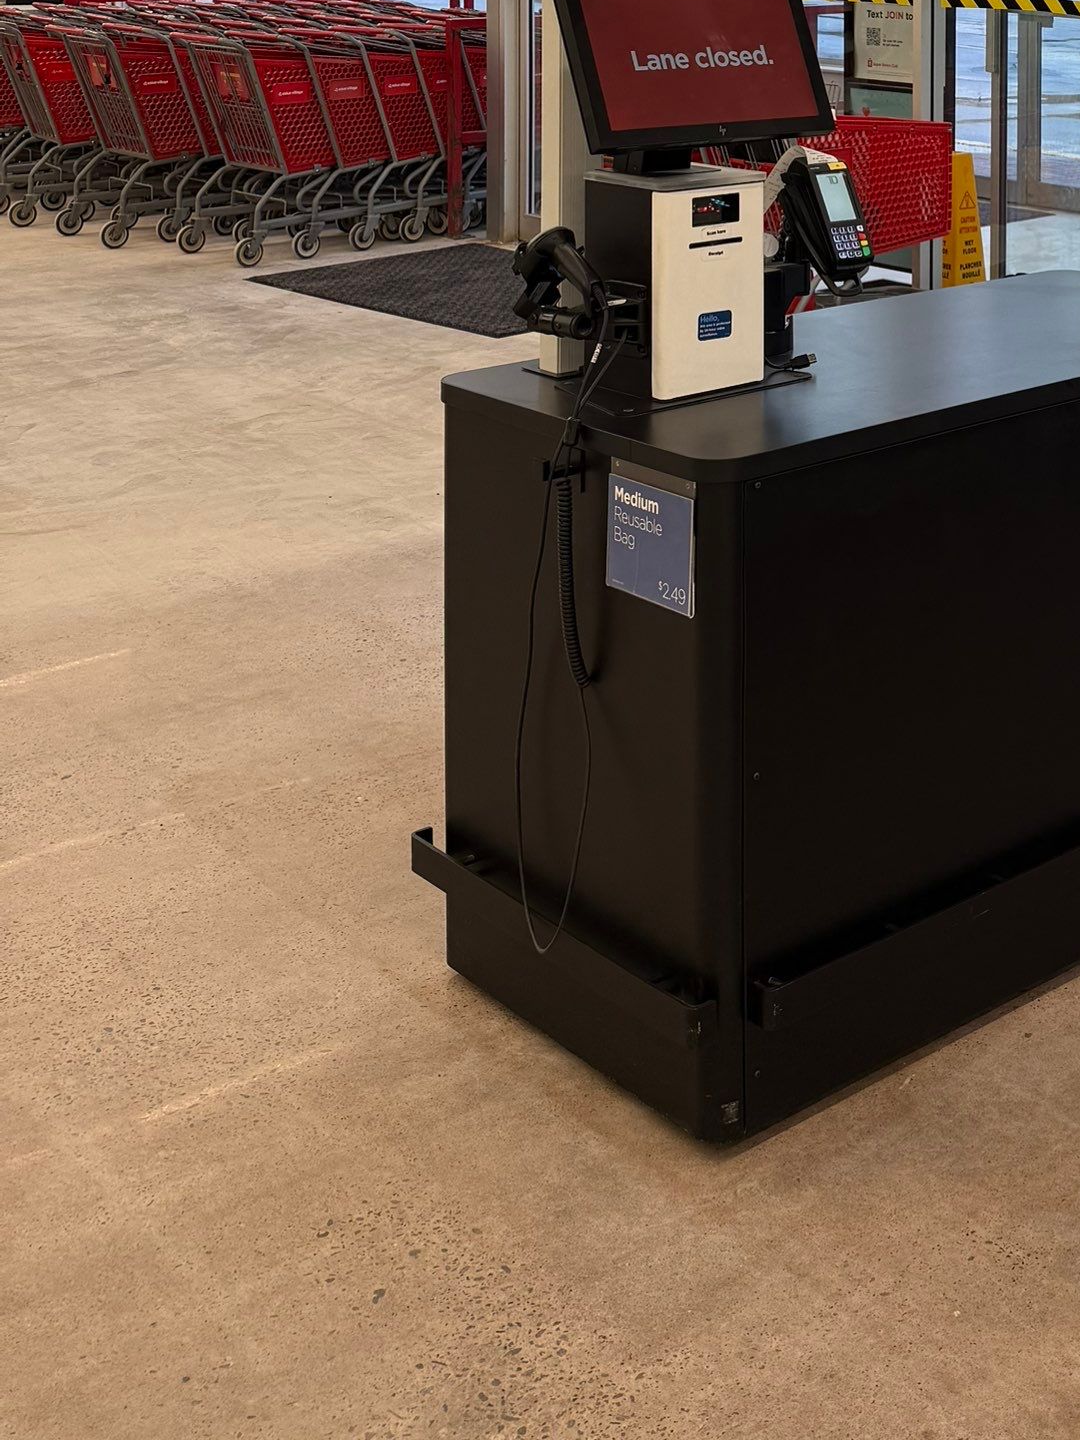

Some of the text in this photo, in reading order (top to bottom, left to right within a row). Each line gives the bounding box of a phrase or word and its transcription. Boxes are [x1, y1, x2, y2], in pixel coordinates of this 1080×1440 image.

[866, 10, 914, 21] Text JOIN to
[630, 45, 775, 72] Lane closed.
[614, 485, 659, 514] Medium
[613, 506, 663, 536] Reusable
[613, 526, 636, 549] Bag
[658, 580, 686, 605] $2.49
